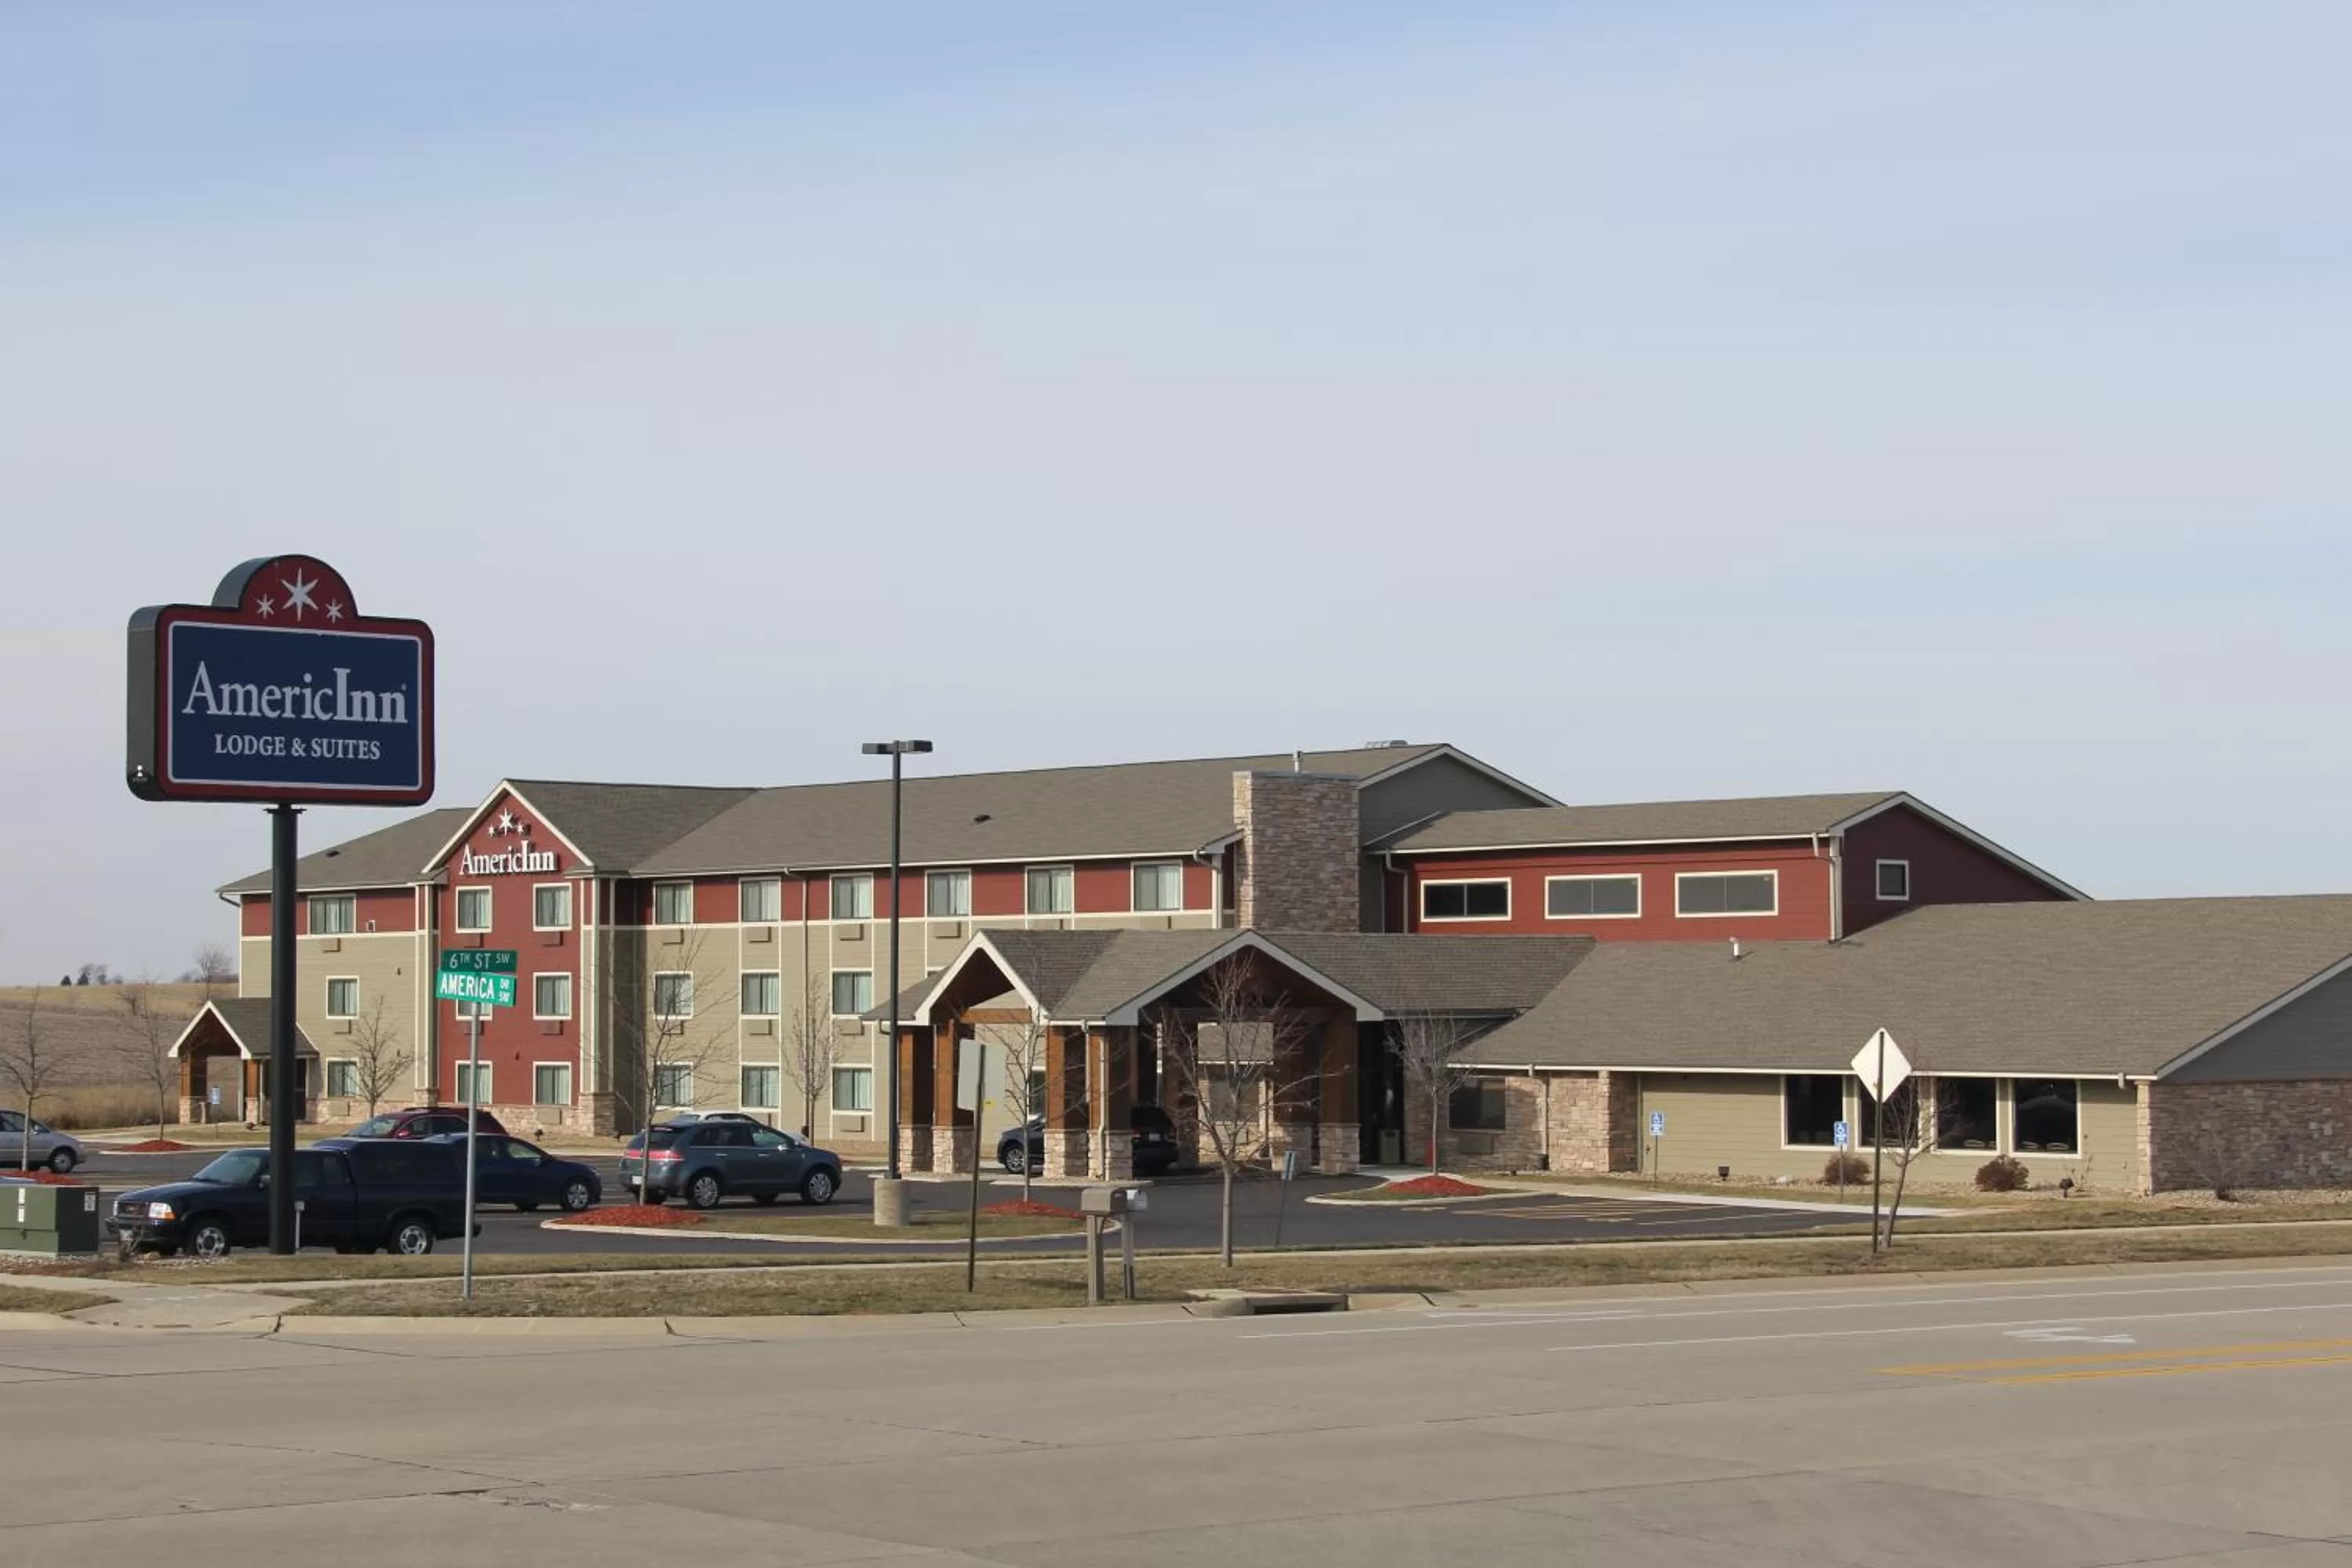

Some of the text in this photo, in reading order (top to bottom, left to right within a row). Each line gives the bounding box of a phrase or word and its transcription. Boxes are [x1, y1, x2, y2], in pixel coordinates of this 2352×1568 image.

[181, 660, 408, 723] AmericInn
[214, 734, 380, 760] LODGE & SUITES
[459, 840, 557, 876] AmericInn
[449, 953, 510, 970] 6TH ST SW
[439, 973, 495, 1000] AMERICA
